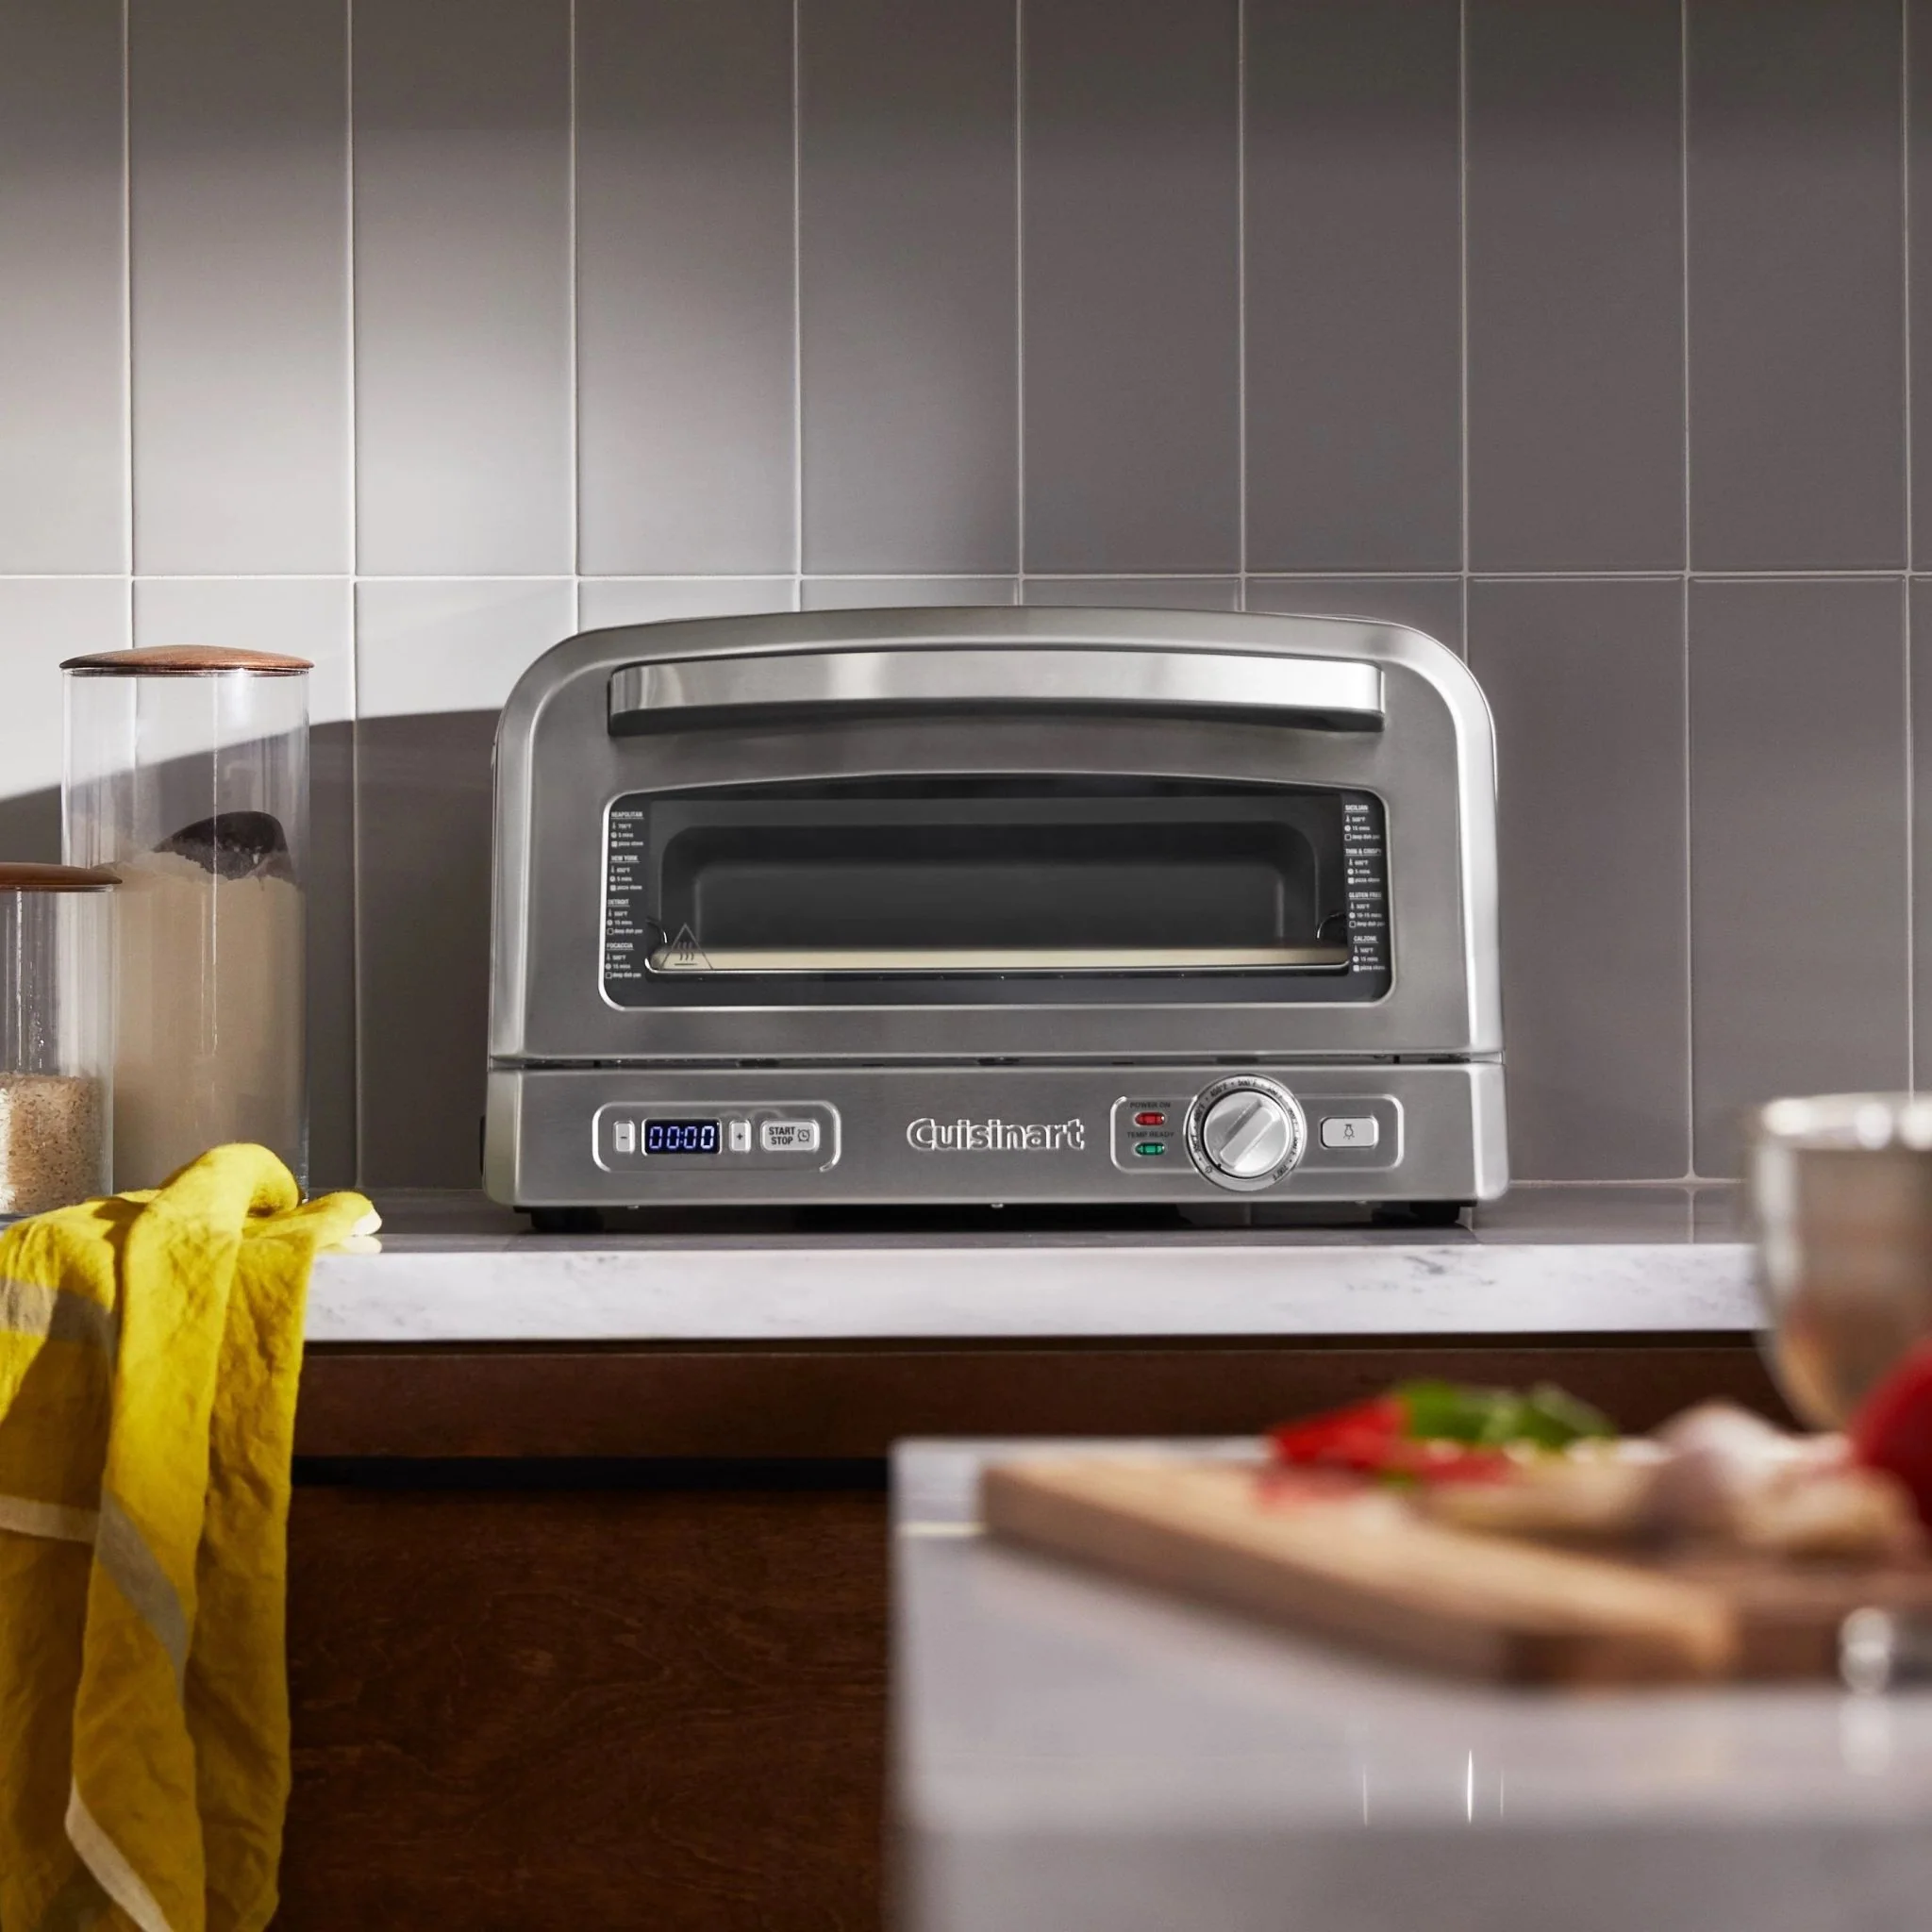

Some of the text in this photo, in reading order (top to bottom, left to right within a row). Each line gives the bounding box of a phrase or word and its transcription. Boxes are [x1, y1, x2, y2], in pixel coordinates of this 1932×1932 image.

[649, 1125, 715, 1150] 00:00
[769, 1126, 795, 1135] START
[907, 1118, 1085, 1150] Cuisinart
[771, 1137, 793, 1145] STOP
